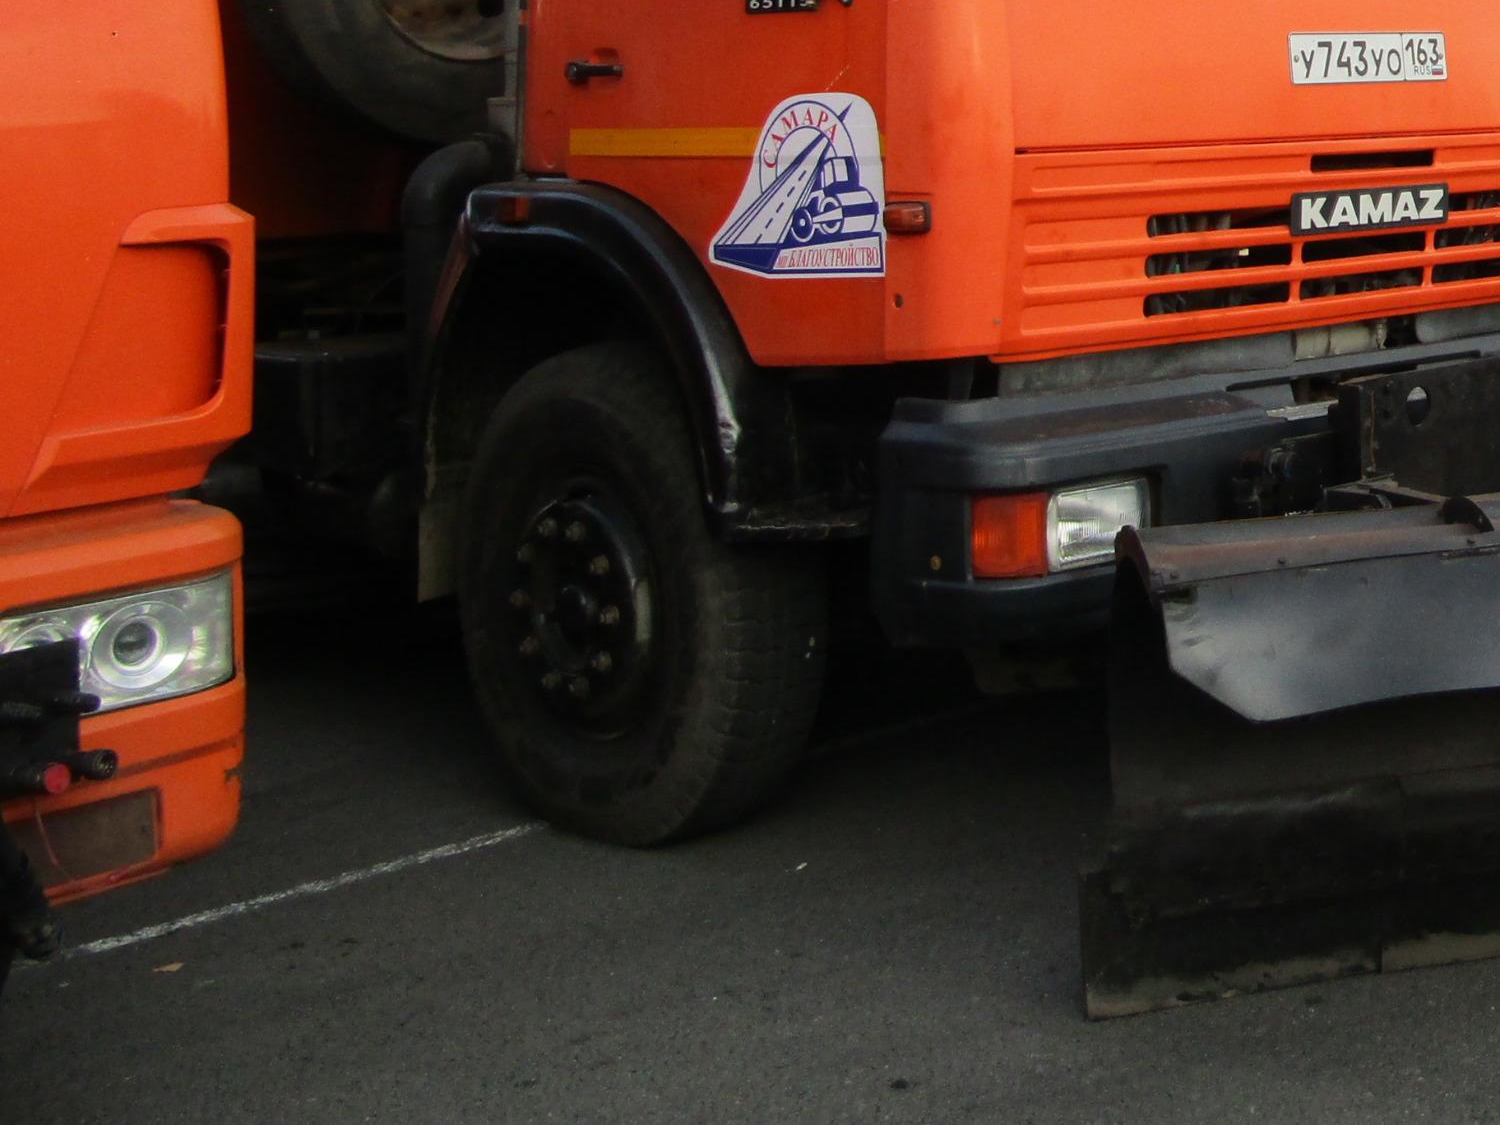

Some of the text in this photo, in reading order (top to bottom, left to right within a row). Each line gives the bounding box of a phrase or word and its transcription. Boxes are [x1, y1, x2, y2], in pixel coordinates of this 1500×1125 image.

[1405, 39, 1439, 66] 163
[1413, 65, 1431, 75] RUS
[763, 107, 838, 169] САМАРА
[1301, 189, 1444, 231] KAMAZ
[788, 243, 879, 268] БЛАГОУСТРОЙСТВО
